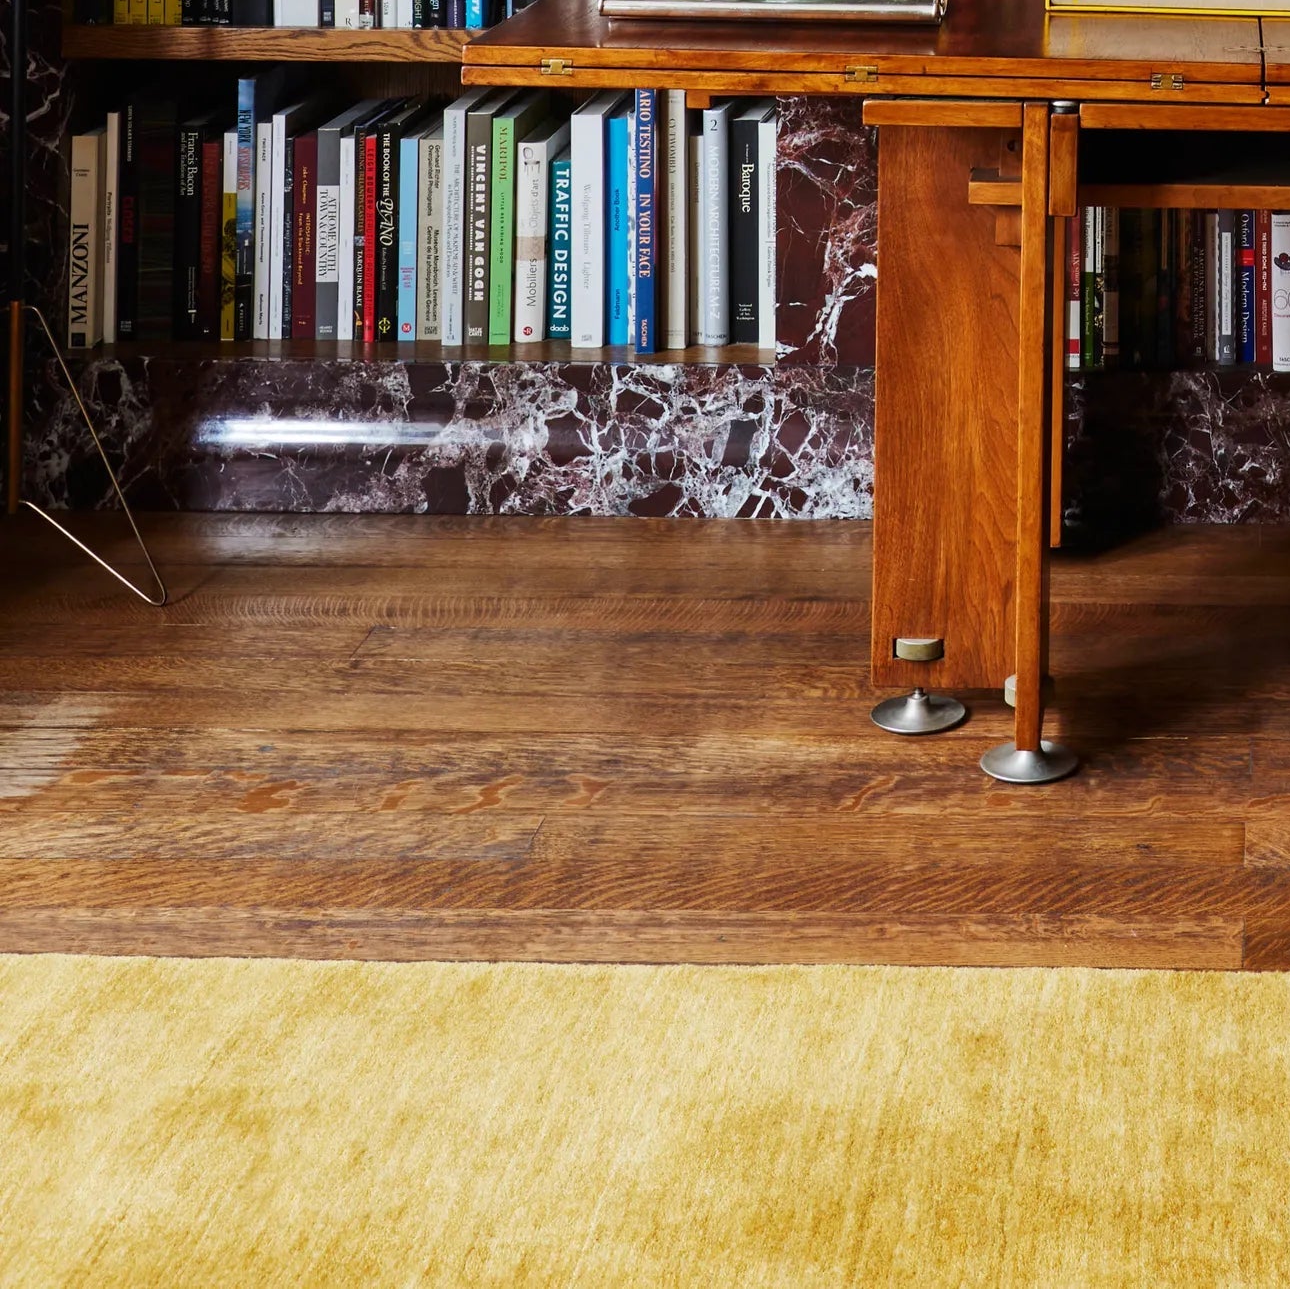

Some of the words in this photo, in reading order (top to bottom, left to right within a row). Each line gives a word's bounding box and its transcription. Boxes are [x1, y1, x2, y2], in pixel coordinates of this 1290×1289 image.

[186, 133, 198, 165] Francis
[186, 166, 197, 196] Bacon
[475, 145, 486, 212] VINCENT
[739, 164, 754, 213] Baroque
[555, 169, 569, 243] TRAFFIC
[475, 219, 486, 251] VAN
[73, 224, 88, 324] MANZONI
[474, 257, 486, 301] GOGH
[553, 249, 568, 319] DESIGN
